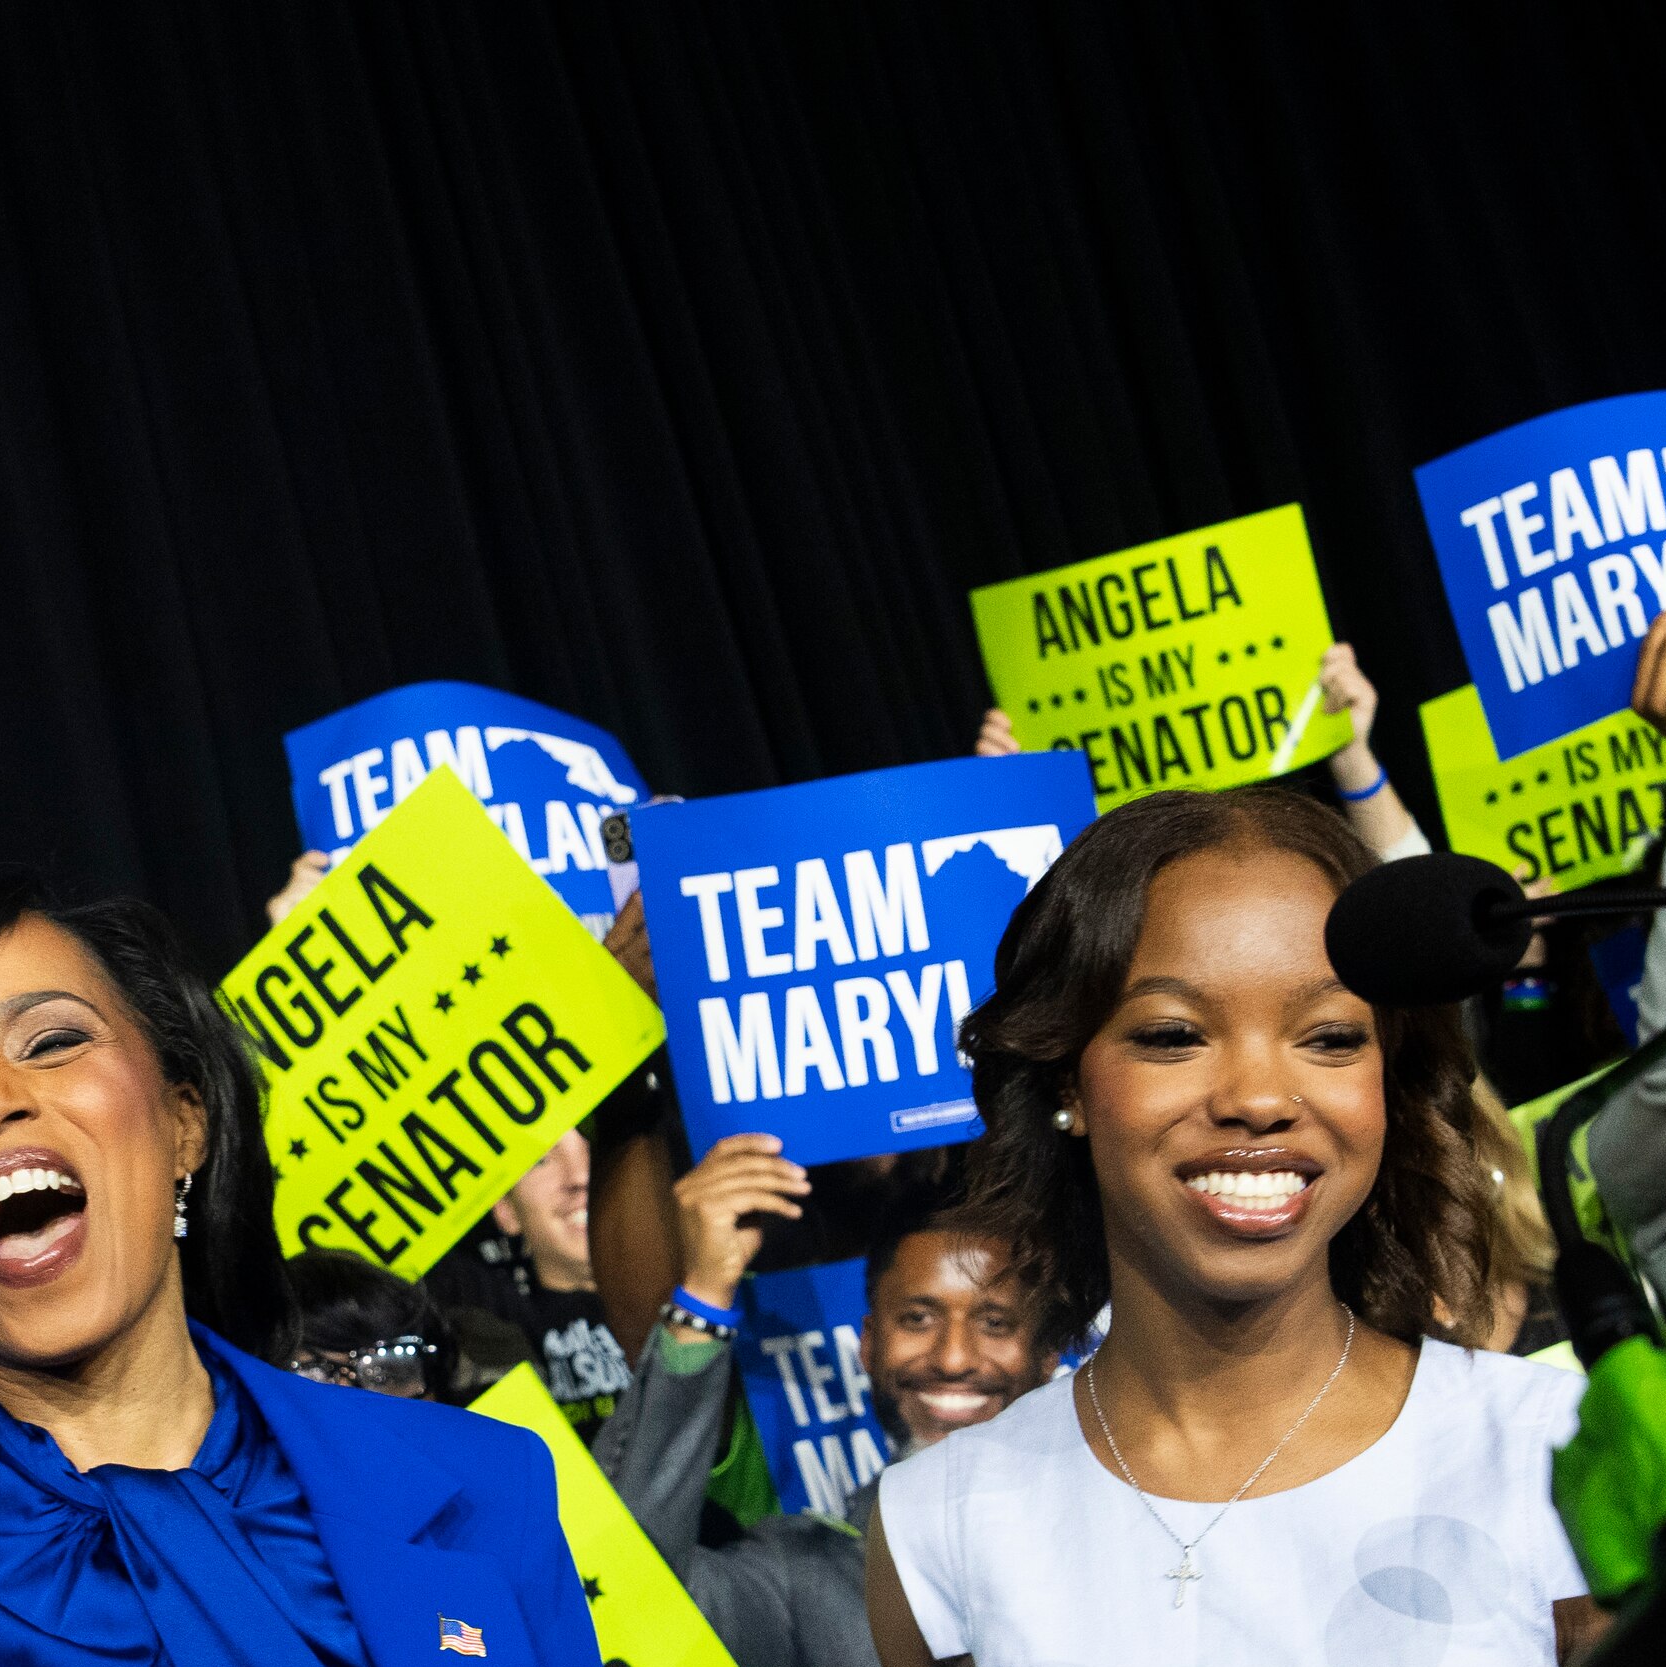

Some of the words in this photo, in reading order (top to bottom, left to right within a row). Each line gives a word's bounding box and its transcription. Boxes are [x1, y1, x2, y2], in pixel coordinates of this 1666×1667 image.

[1031, 544, 1243, 660] ANGELA
[1097, 660, 1137, 708] IS
[1139, 643, 1197, 700] MY
[319, 725, 494, 840] TEAM
[1562, 741, 1601, 788] IS
[1607, 725, 1665, 774] MY
[679, 842, 932, 983] TEAM
[303, 1073, 368, 1146] IS
[346, 1003, 431, 1102] MY
[697, 958, 975, 1106] MARYL
[760, 1324, 871, 1428] TEA
